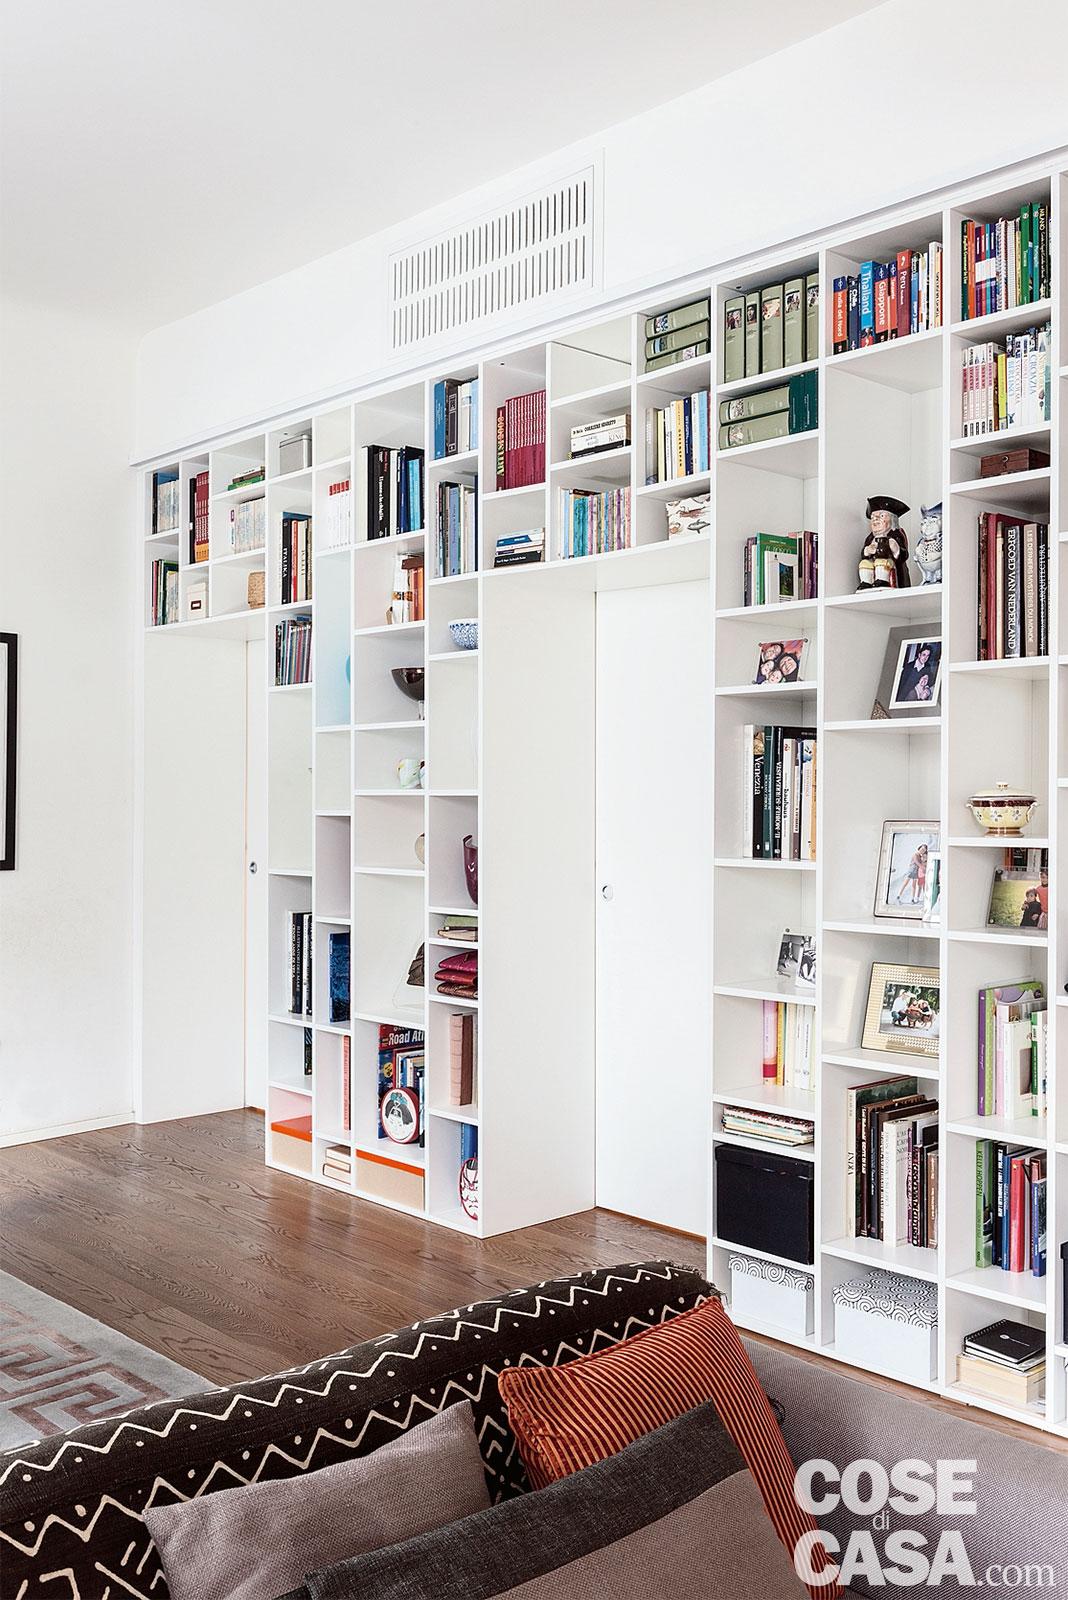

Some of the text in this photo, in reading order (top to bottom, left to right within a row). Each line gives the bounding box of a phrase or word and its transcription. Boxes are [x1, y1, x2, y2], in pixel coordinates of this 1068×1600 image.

[861, 270, 871, 315] Thailand
[754, 756, 764, 795] Venezia
[388, 1031, 410, 1046] Road
